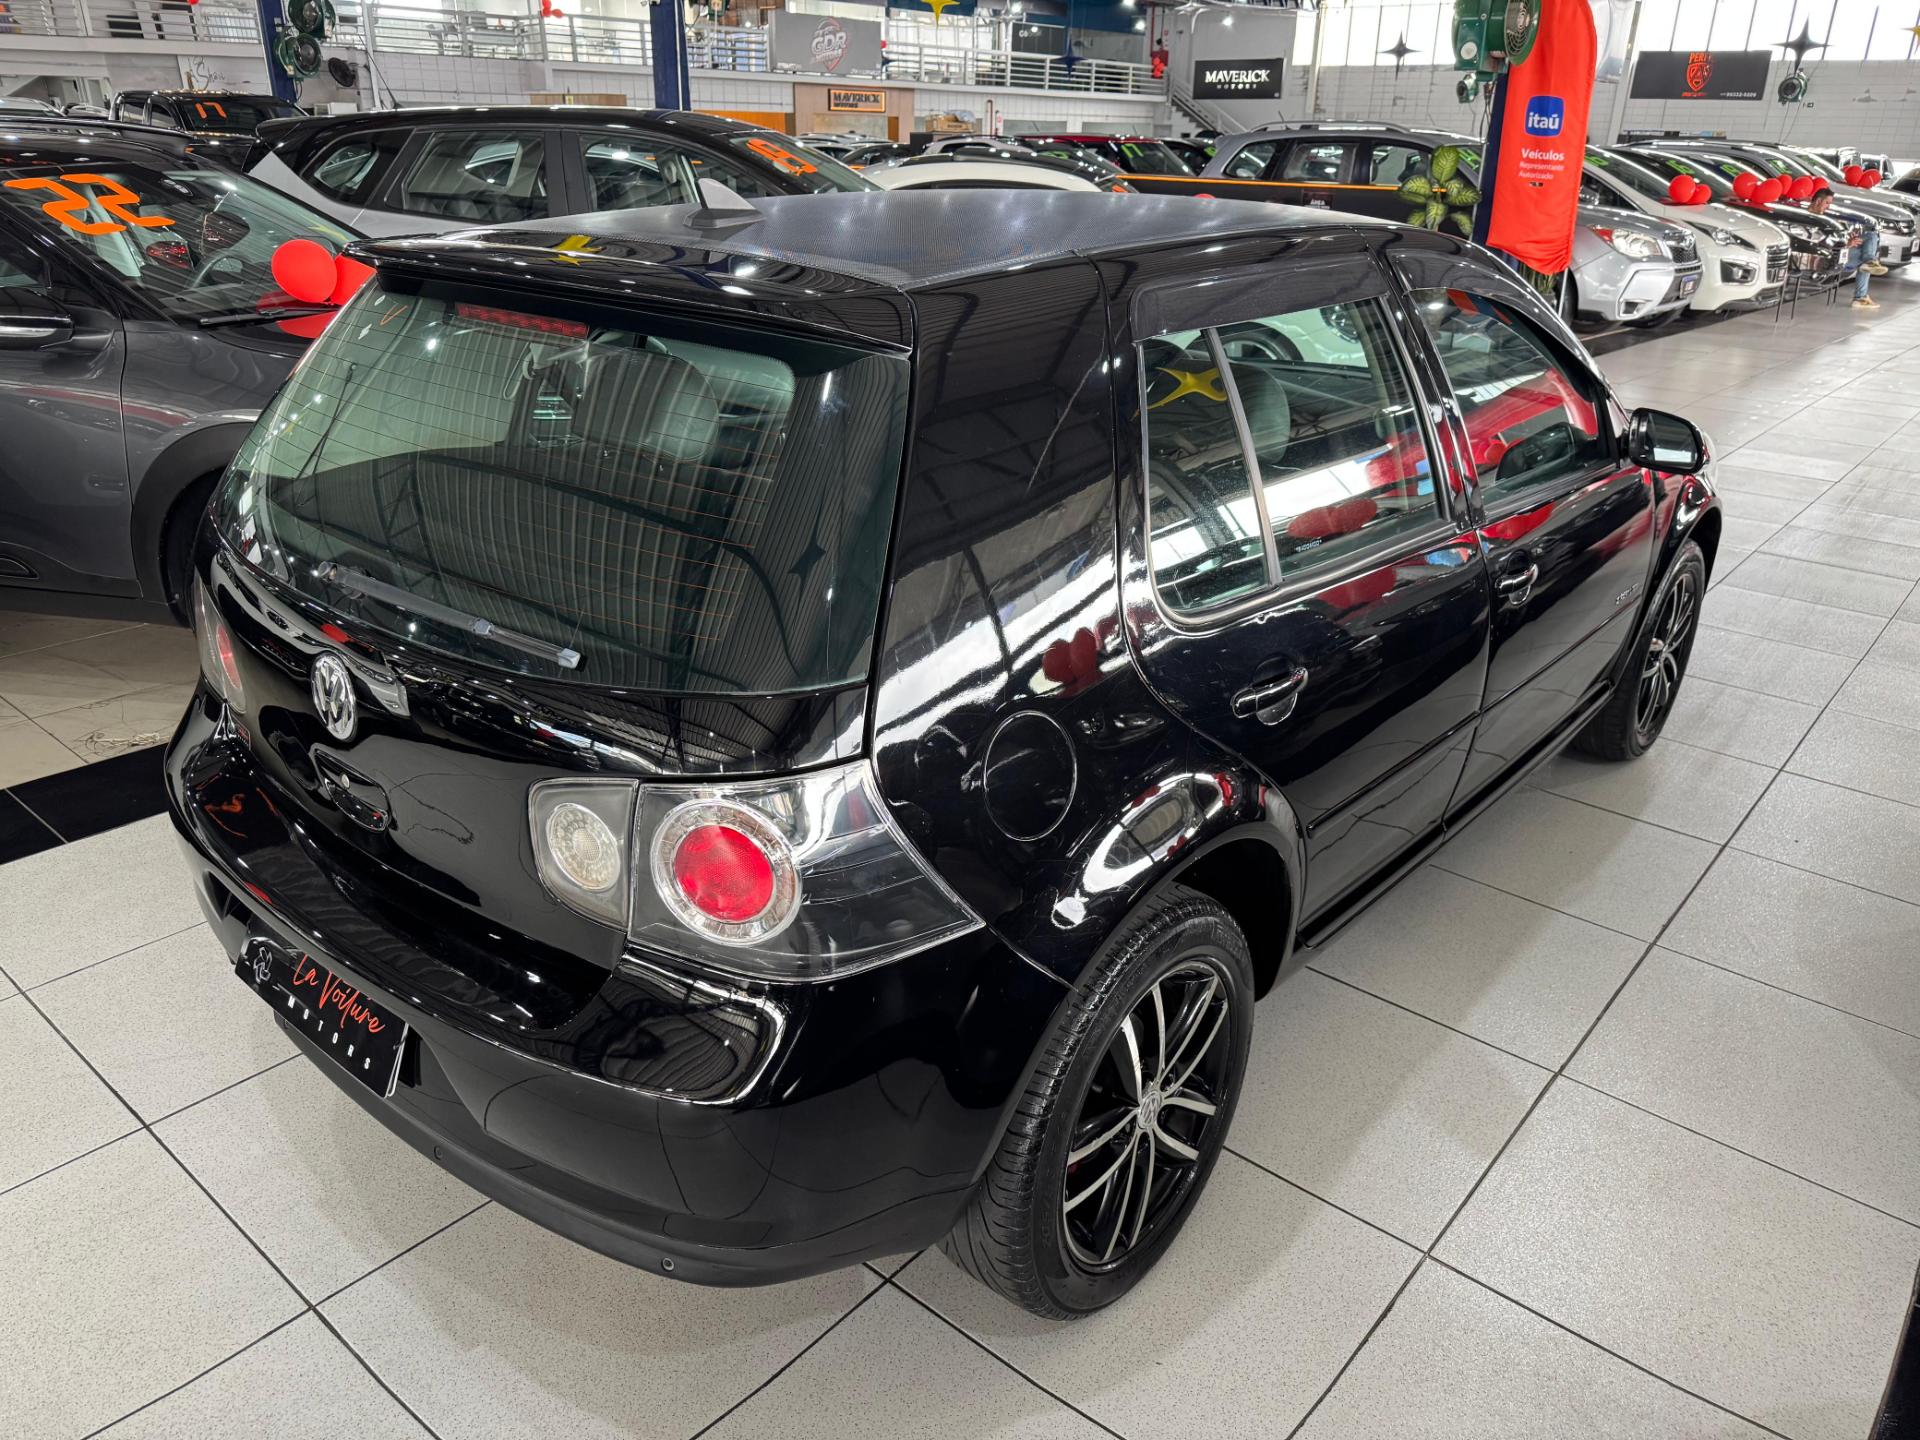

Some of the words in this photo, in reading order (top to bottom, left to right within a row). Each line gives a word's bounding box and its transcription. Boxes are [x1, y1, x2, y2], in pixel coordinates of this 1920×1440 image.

[811, 31, 847, 54] GDR
[1204, 69, 1270, 83] MAVERICK
[833, 92, 881, 104] MAVERICK
[195, 102, 227, 119] 17
[1527, 111, 1560, 130] itaú
[1521, 148, 1566, 161] Veículos
[1518, 171, 1554, 180] Autorizado
[2, 172, 177, 236] 22
[292, 953, 319, 986] La
[287, 994, 371, 1070] MOTORS
